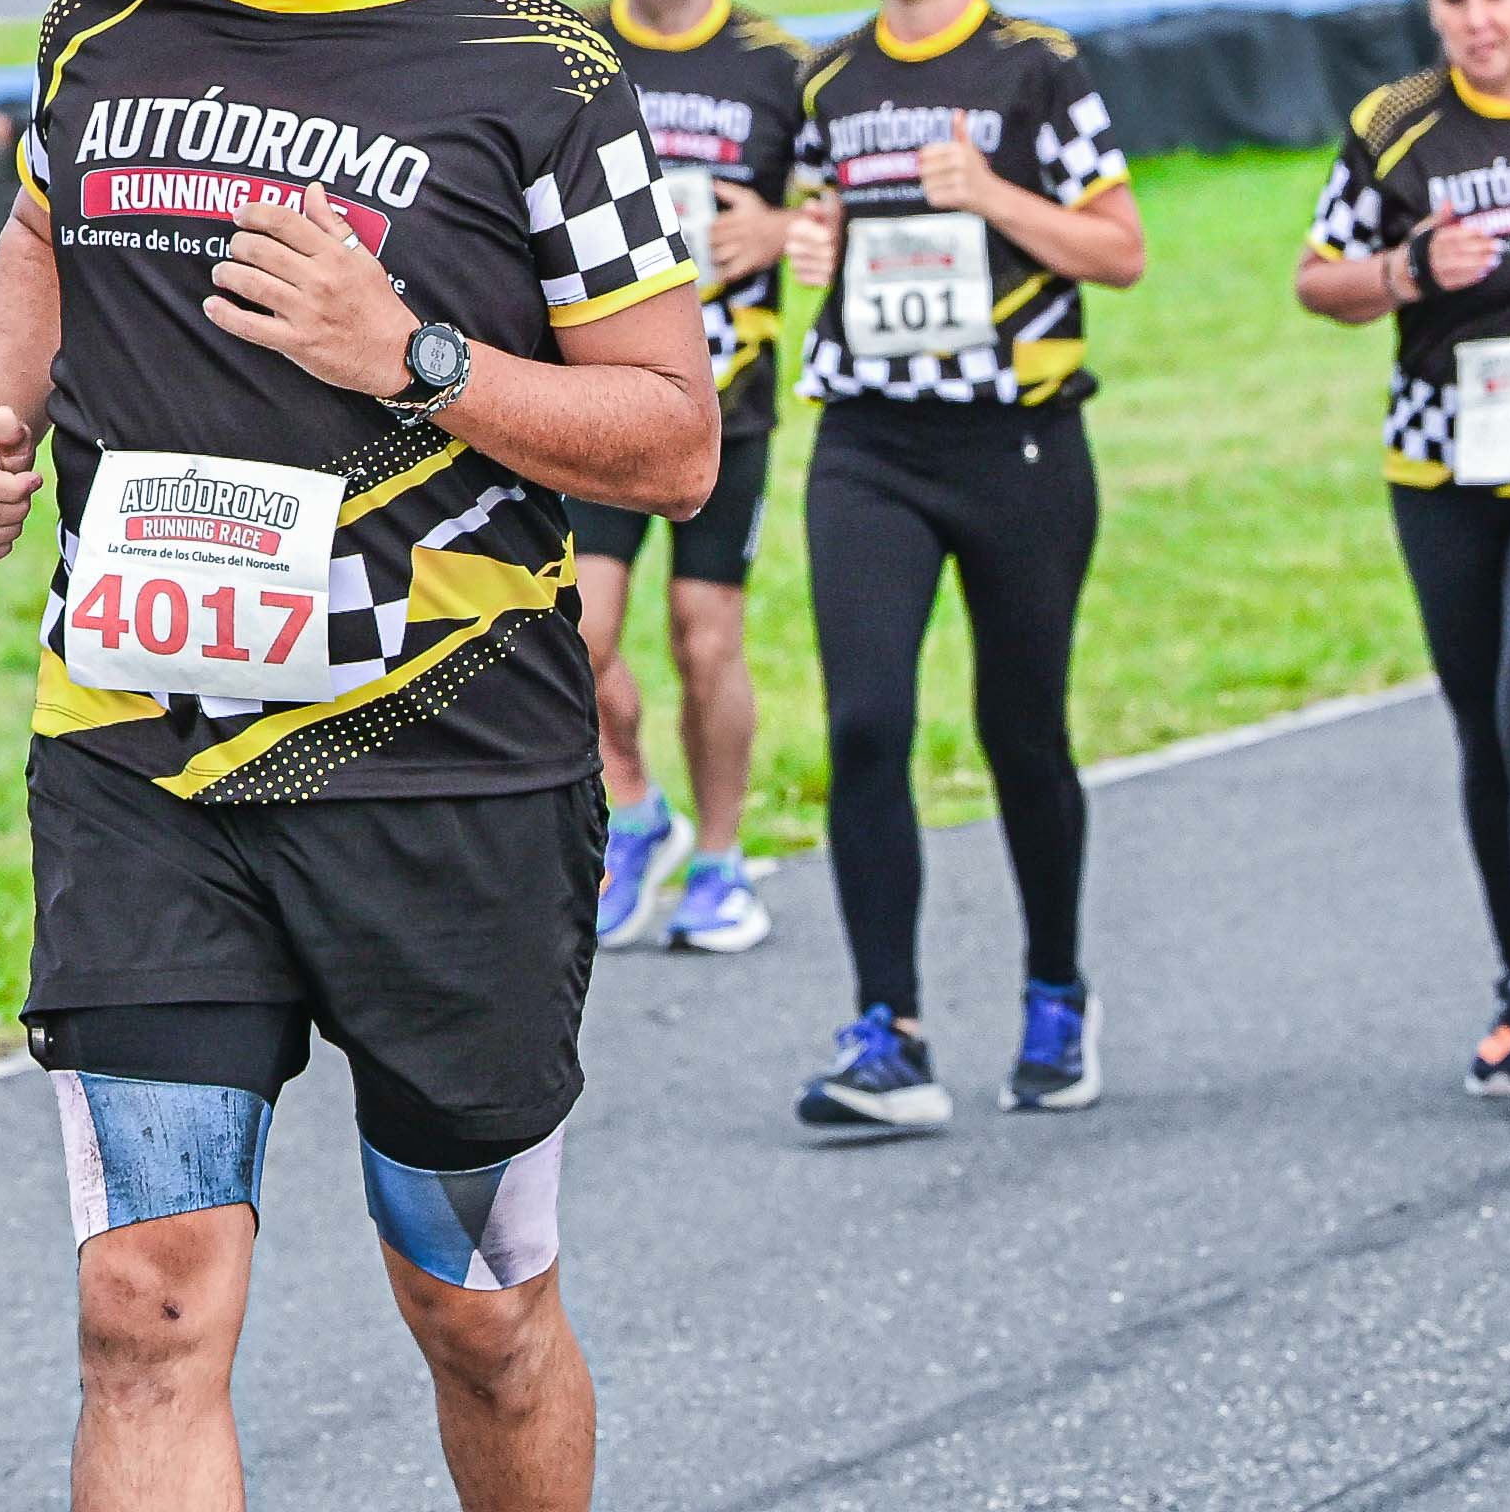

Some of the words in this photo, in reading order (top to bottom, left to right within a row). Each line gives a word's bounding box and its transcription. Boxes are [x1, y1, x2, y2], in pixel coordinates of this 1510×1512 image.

[75, 86, 430, 208] AUTÓDROMO
[111, 174, 251, 214] RUNNING
[78, 224, 141, 249] Carrera
[145, 229, 169, 251] de
[174, 231, 200, 255] los
[869, 289, 962, 332] 101
[120, 469, 299, 529] AUTÓDROMO
[142, 518, 214, 540] RUNNING
[219, 523, 264, 551] RACE
[108, 543, 118, 553] La
[120, 544, 157, 557] Carrera
[160, 548, 173, 559] de
[175, 550, 190, 560] los
[192, 551, 225, 565] Clubes
[228, 555, 243, 567] del
[246, 558, 290, 572] Noroeste
[71, 574, 313, 665] 4017
